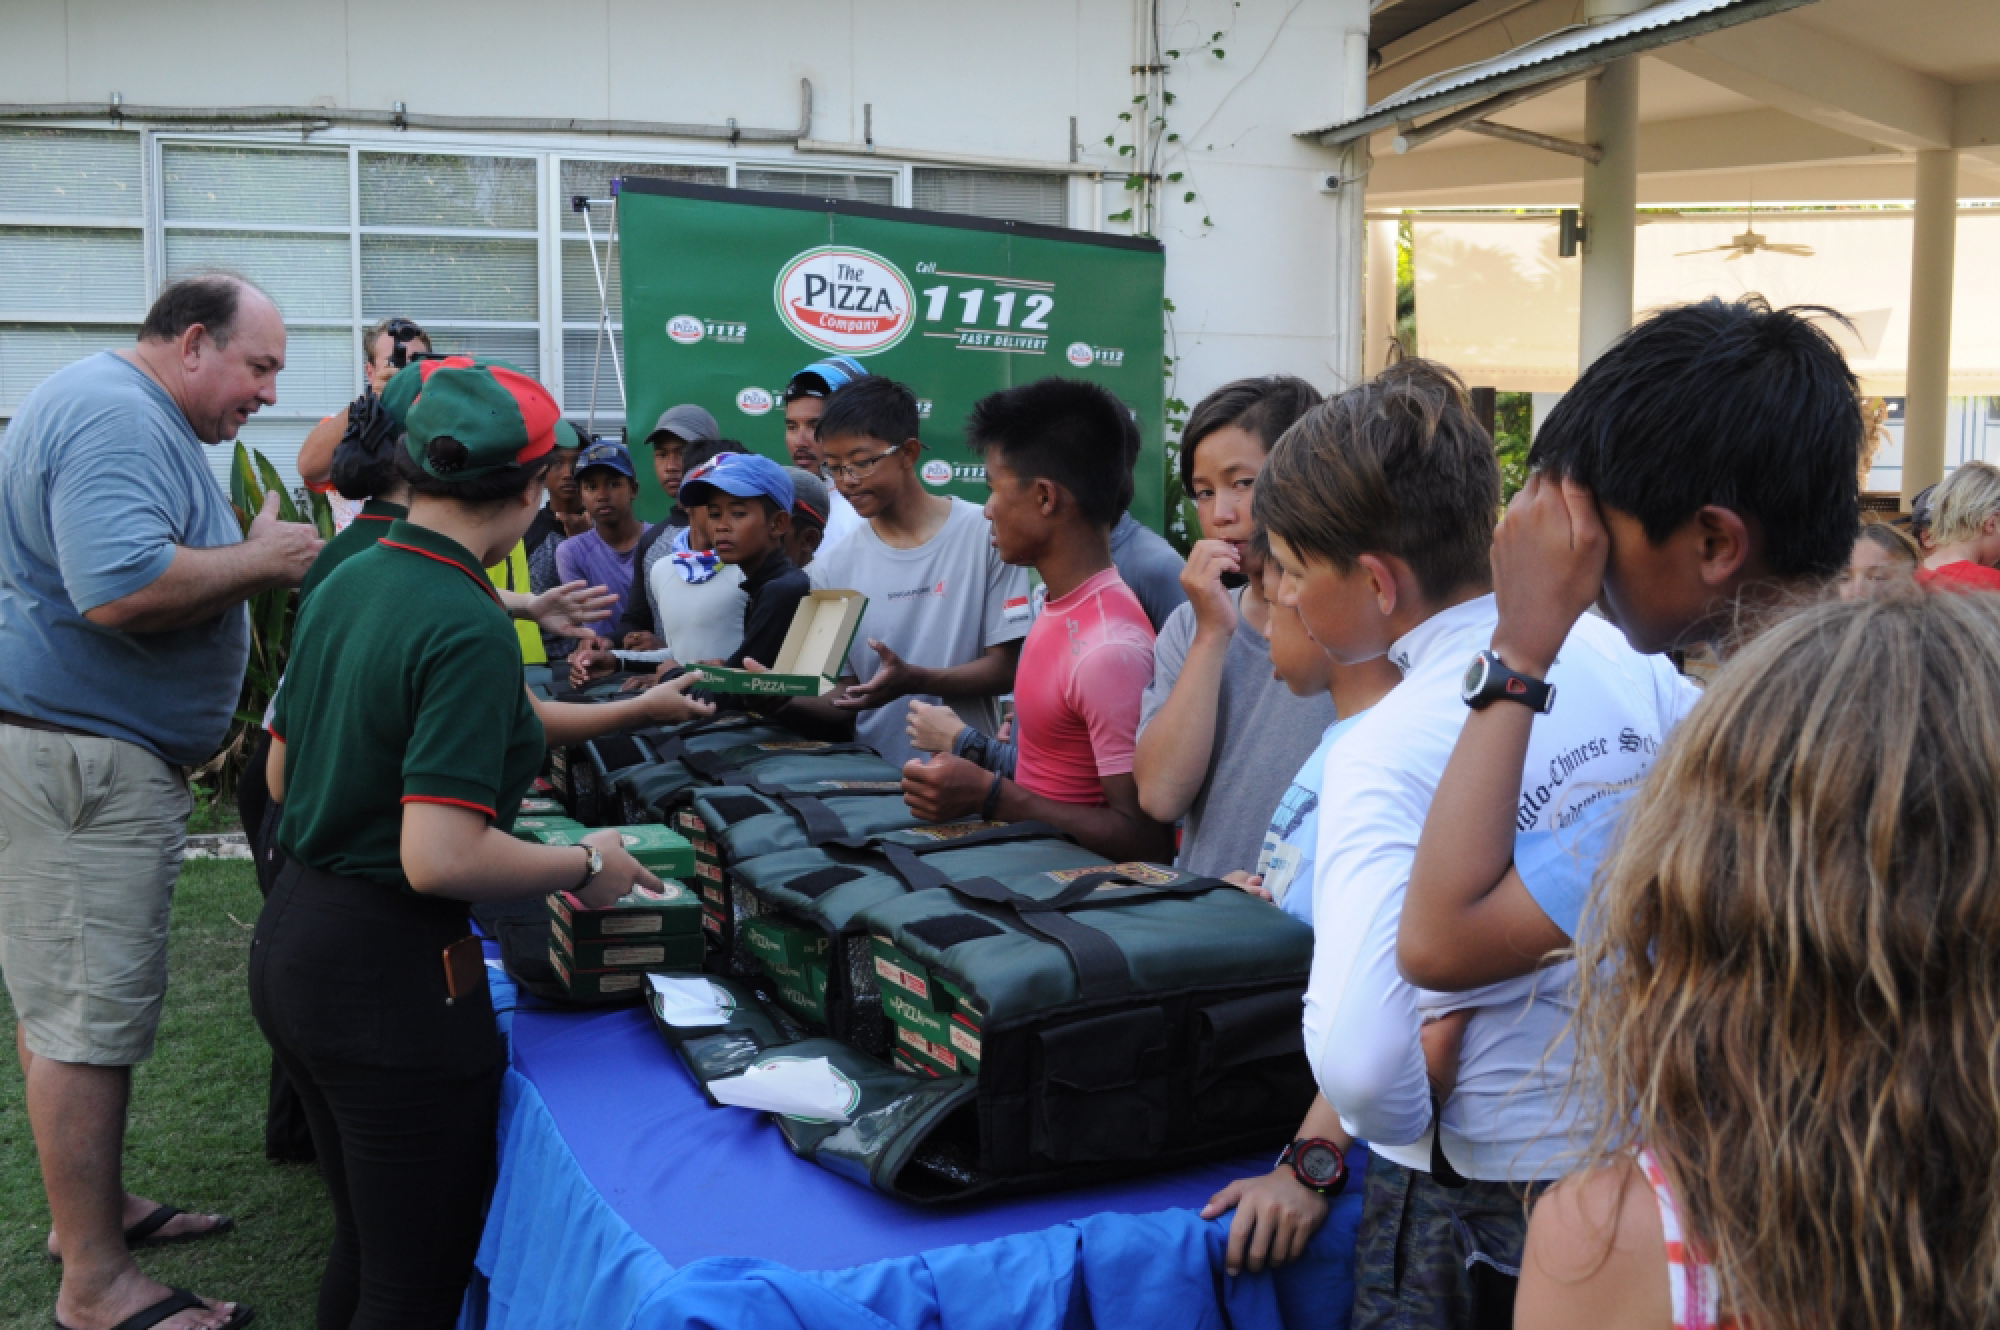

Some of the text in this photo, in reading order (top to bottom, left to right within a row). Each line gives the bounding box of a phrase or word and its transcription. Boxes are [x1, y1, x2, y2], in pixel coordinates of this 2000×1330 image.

[837, 263, 864, 282] The
[915, 261, 937, 274] Call
[804, 273, 894, 314] PIZZA
[922, 284, 1055, 330] 1112
[706, 323, 747, 337] 1112
[819, 312, 879, 333] Company
[959, 333, 1049, 349] FAST DELIVERY
